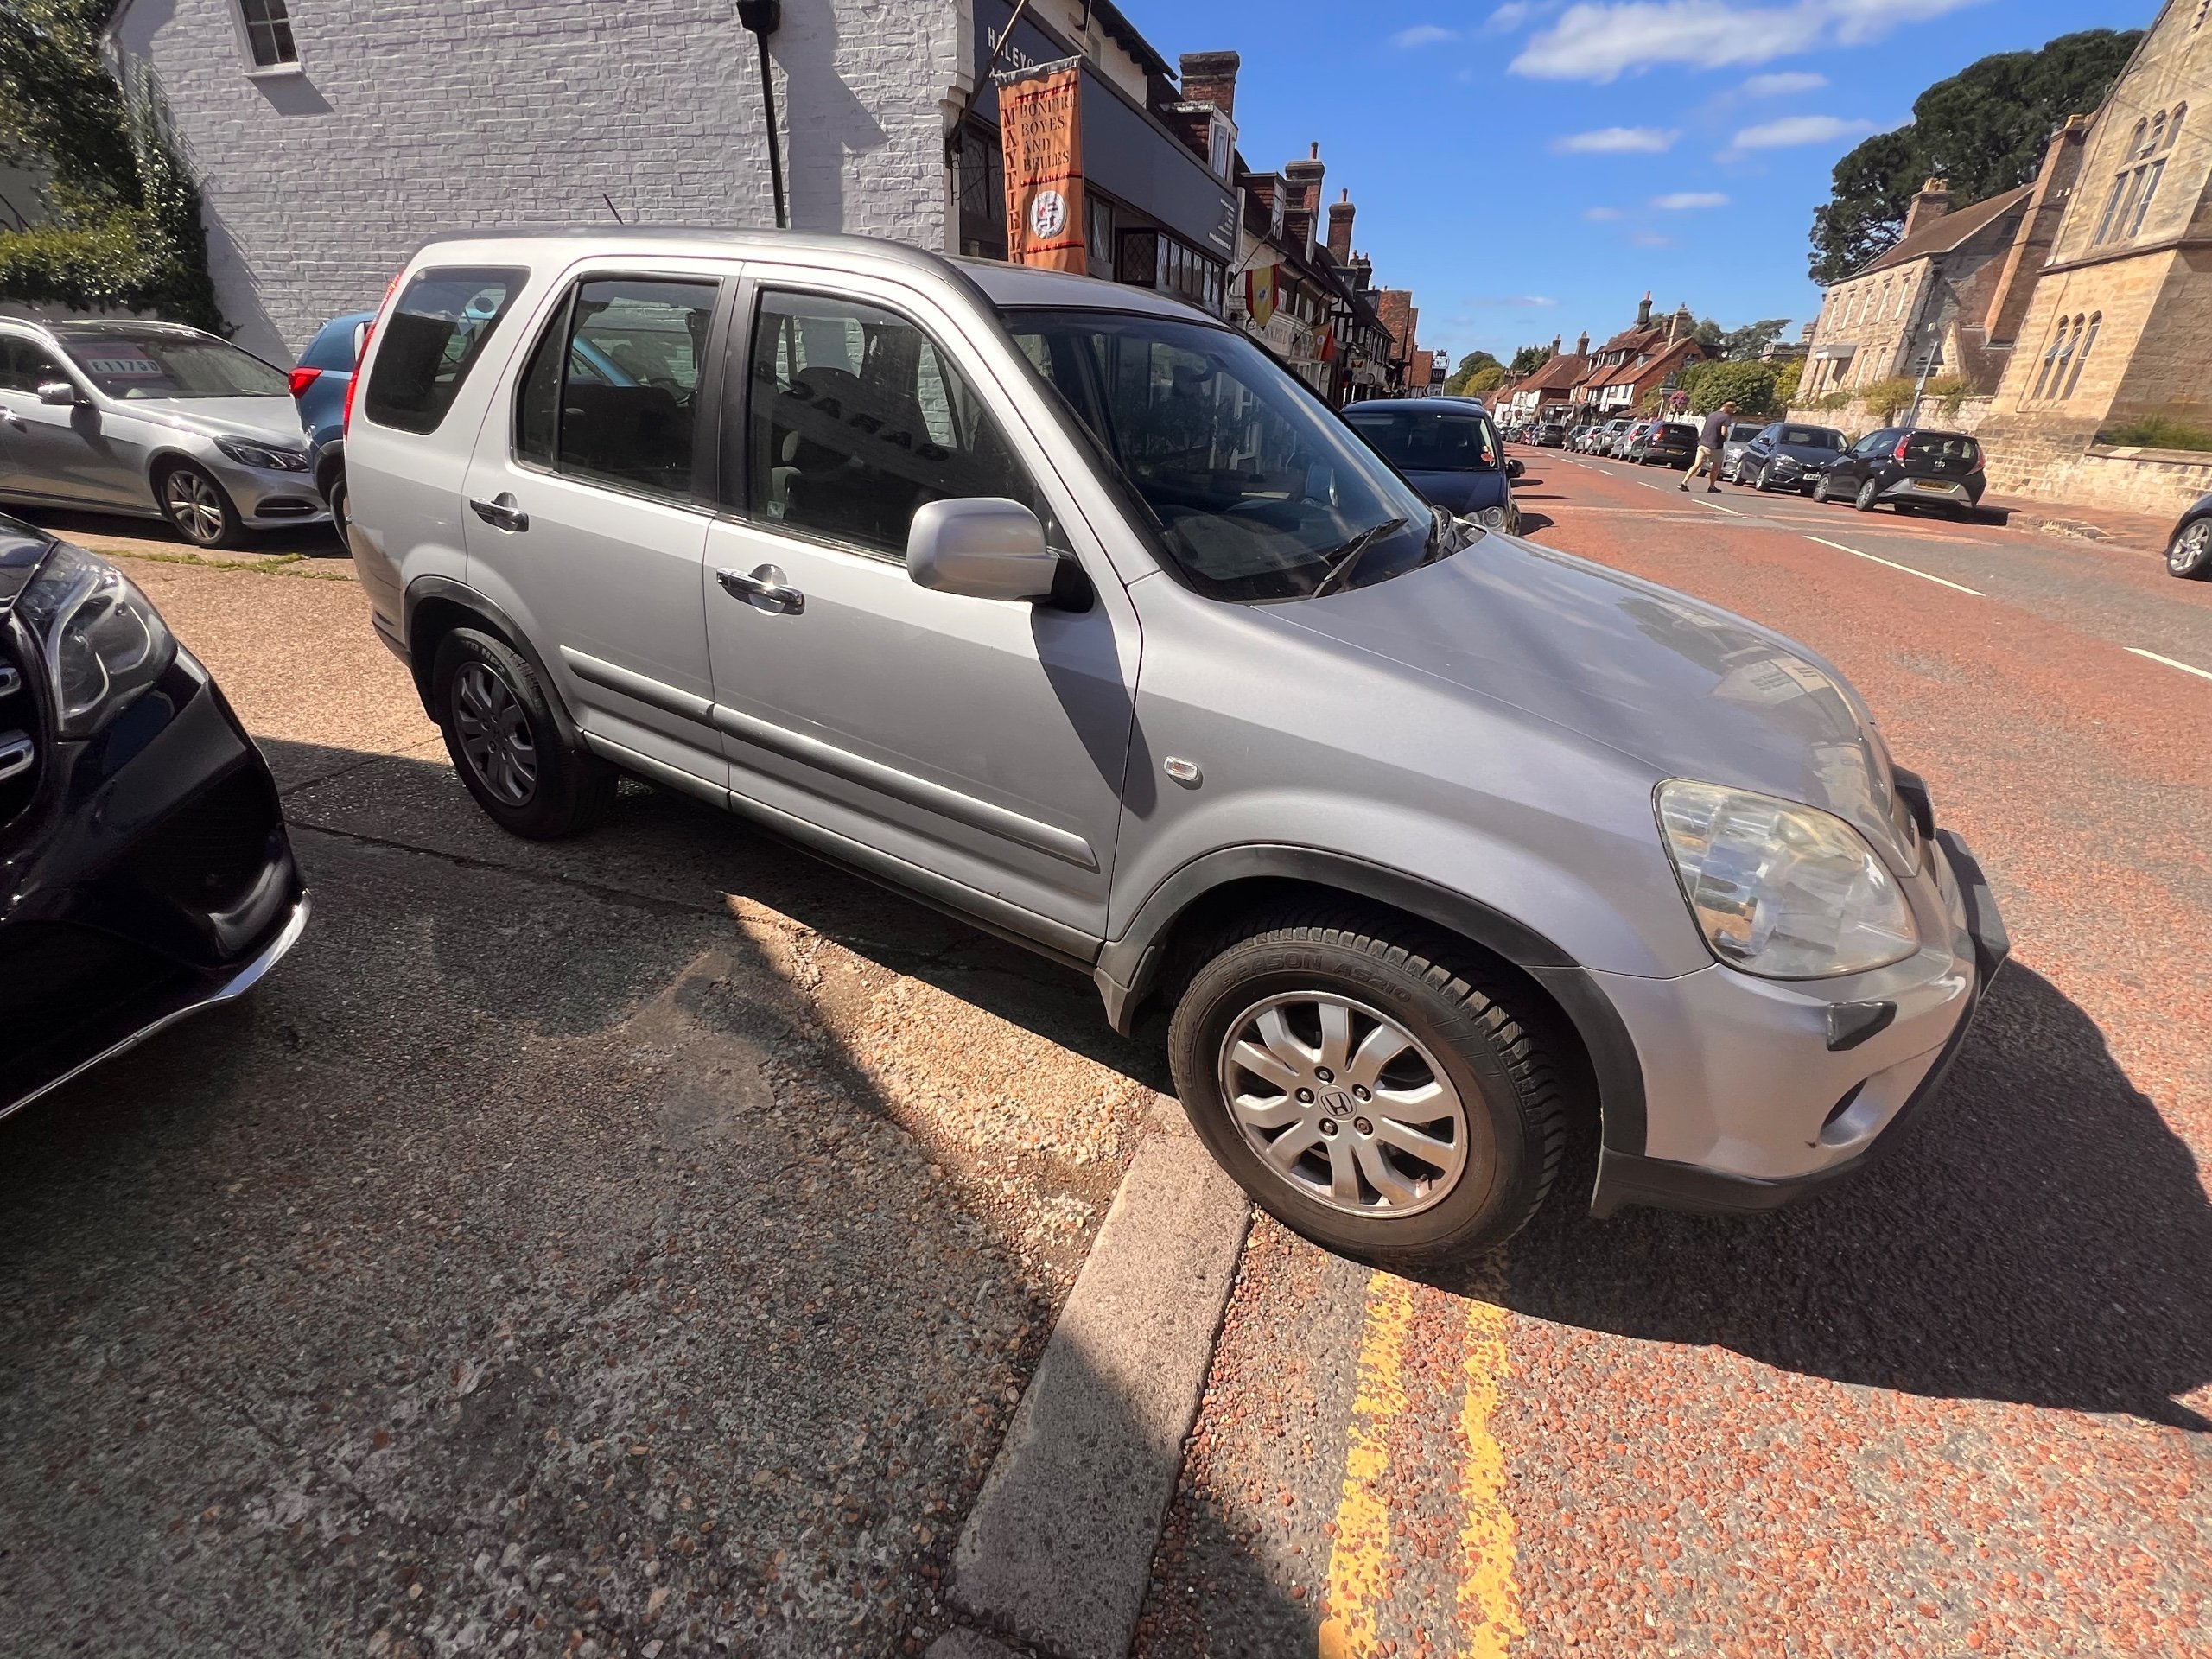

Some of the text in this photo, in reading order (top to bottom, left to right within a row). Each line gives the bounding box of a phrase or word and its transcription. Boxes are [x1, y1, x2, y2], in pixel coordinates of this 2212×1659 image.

[1020, 94, 1077, 118] BONFIRE
[1021, 116, 1065, 137] BOYES
[1023, 138, 1051, 155] AND
[1023, 150, 1069, 172] BELLES
[1218, 952, 1411, 1003] SEASON AS210
